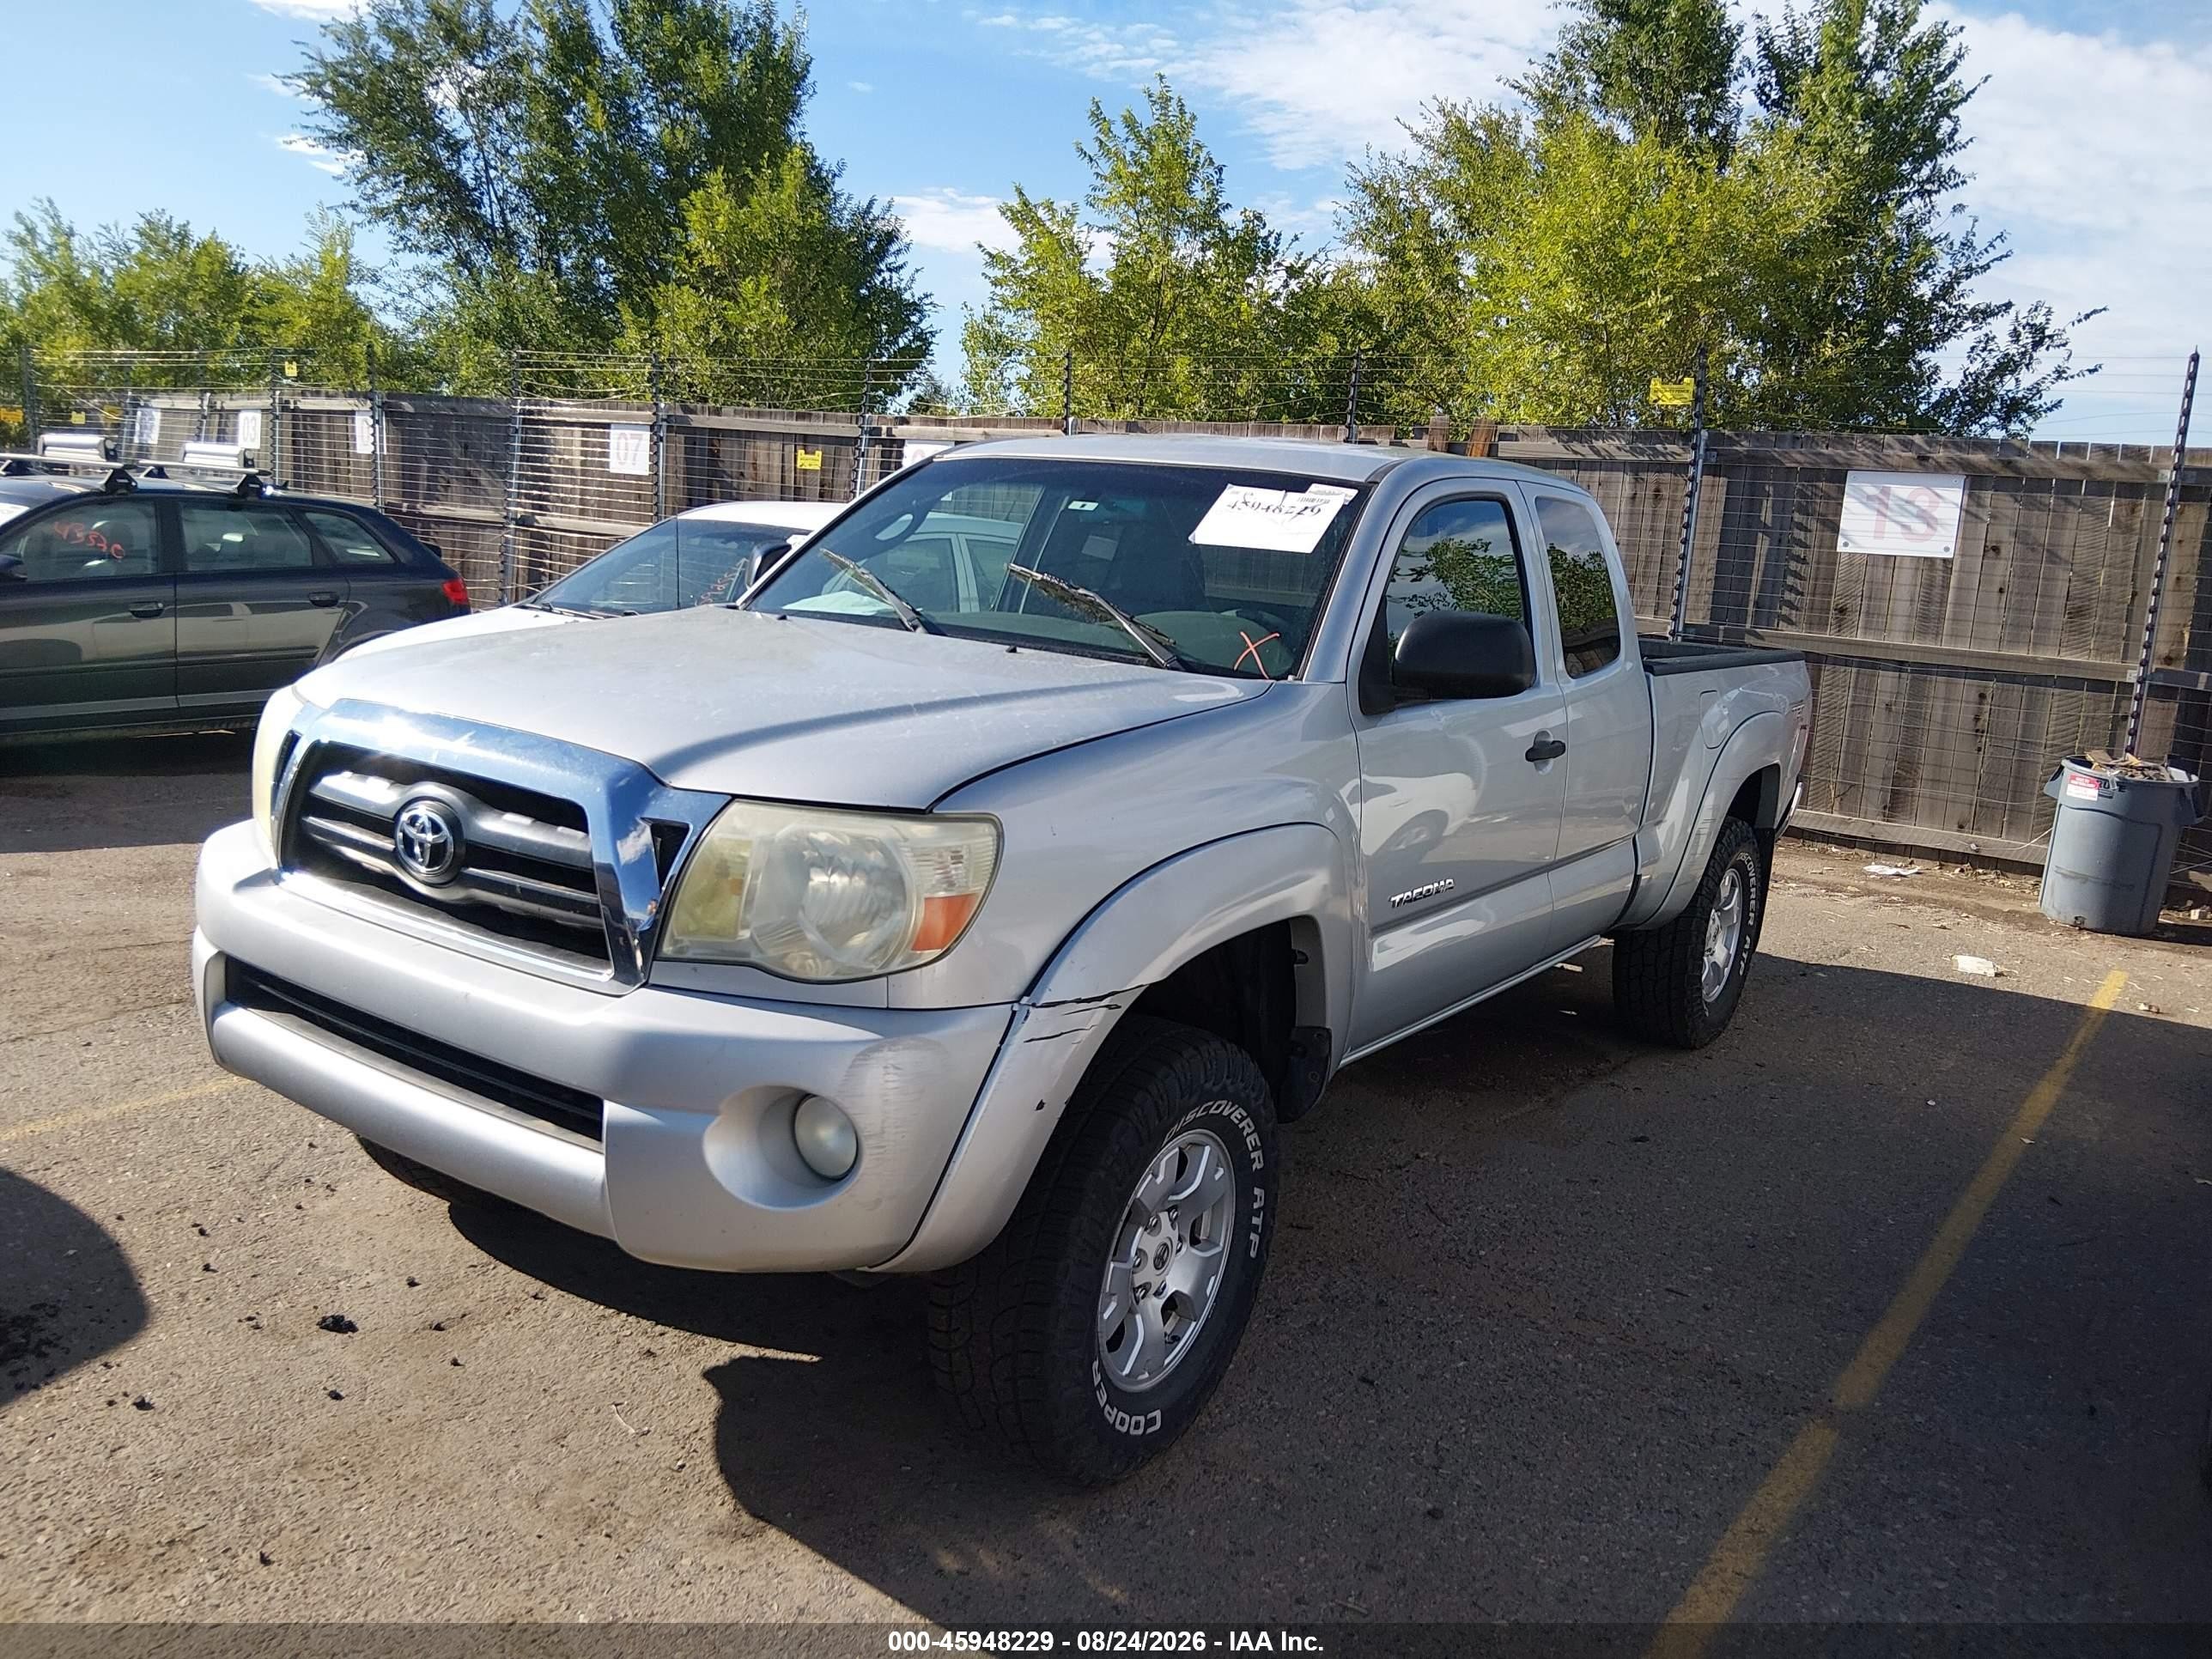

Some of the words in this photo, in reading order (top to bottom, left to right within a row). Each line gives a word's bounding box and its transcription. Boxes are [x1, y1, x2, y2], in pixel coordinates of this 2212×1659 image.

[241, 416, 258, 443] 03
[617, 432, 644, 466] 07
[1865, 486, 1941, 543] 13
[1389, 878, 1455, 908] TACOMA
[1737, 852, 1758, 927] DISCOVERER
[1162, 1099, 1265, 1172] DISCOVERER
[1249, 1186, 1266, 1259] ATP
[1091, 1356, 1163, 1437] COOPER
